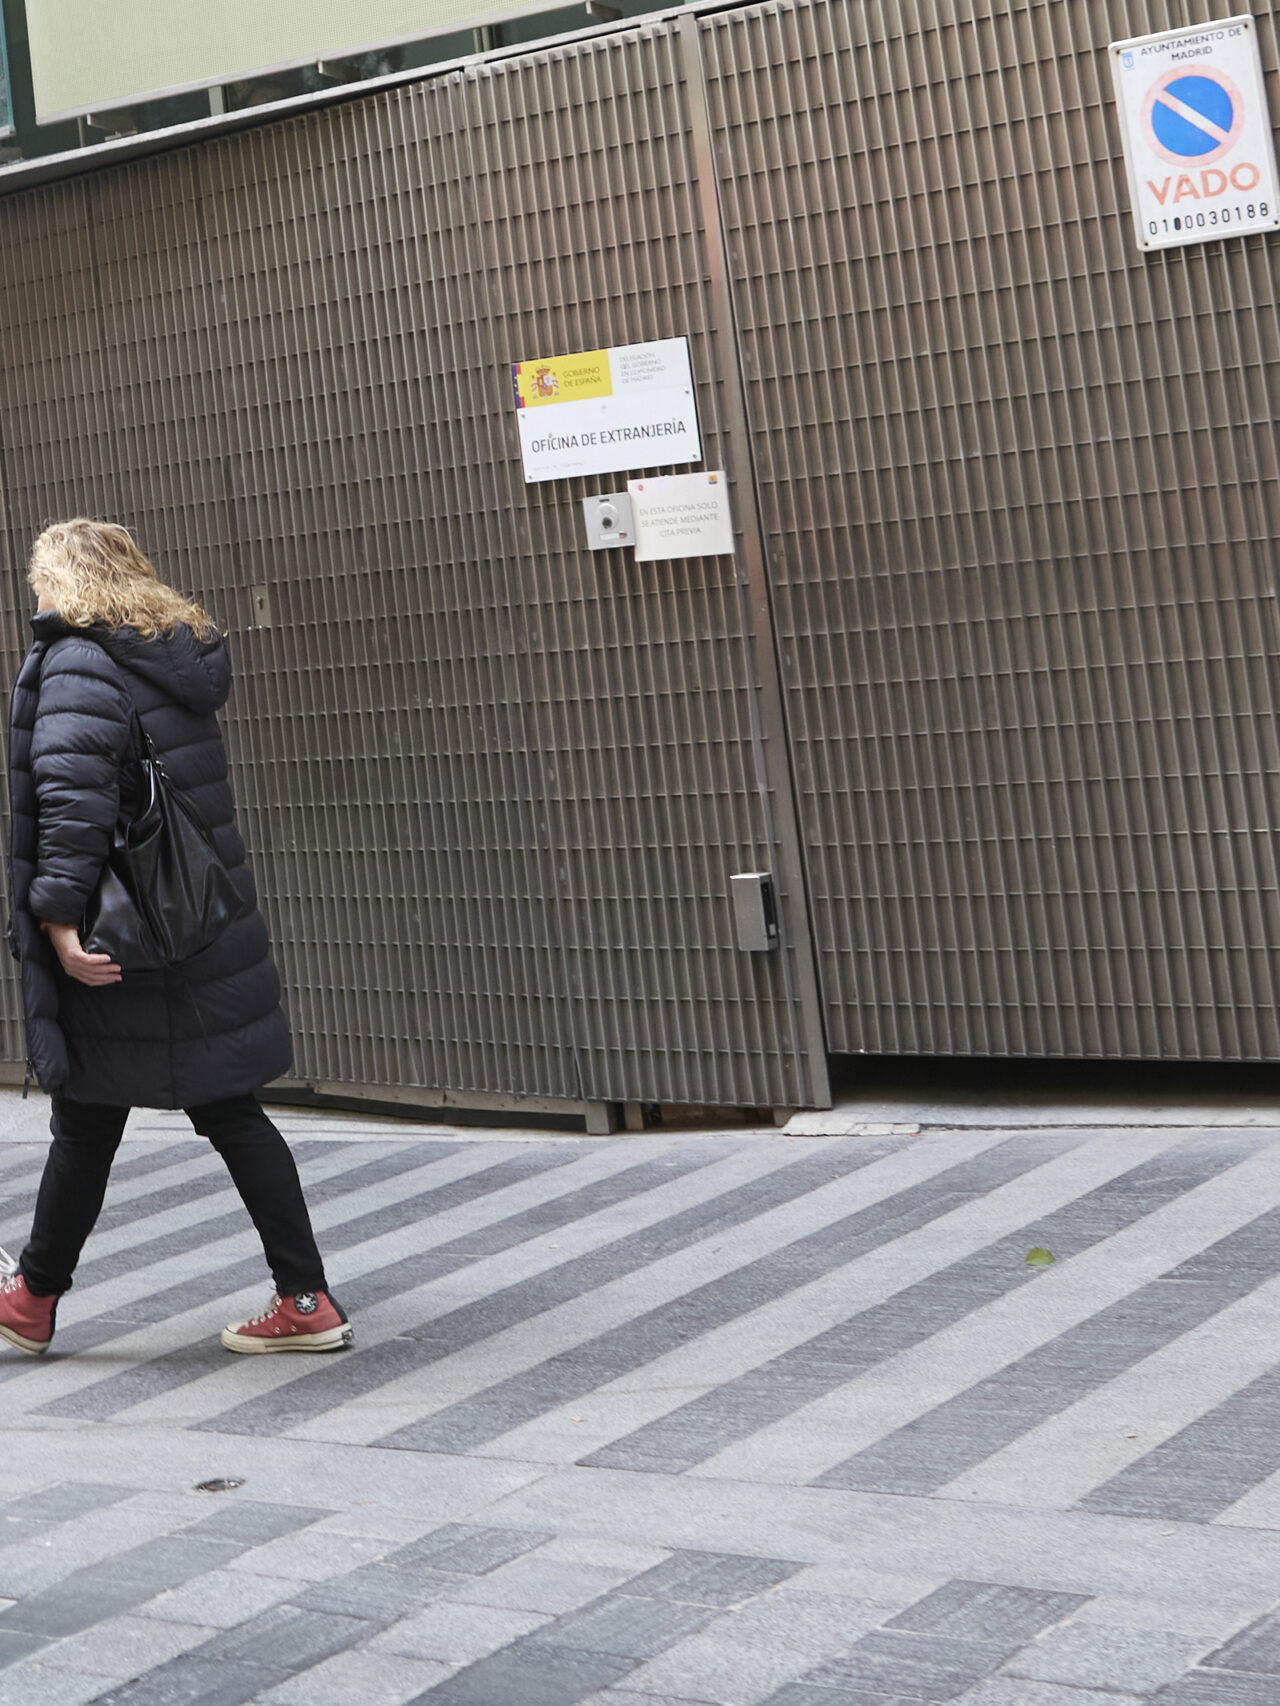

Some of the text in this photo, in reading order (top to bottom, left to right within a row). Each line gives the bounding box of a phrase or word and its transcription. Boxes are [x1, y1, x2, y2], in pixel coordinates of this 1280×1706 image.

[1140, 27, 1242, 56] AYUNTAMIENTO DE
[1171, 46, 1213, 61] MADRID
[1146, 162, 1260, 206] VADO
[562, 366, 600, 378] GOBIERNO
[563, 380, 573, 388] DE
[531, 419, 686, 453] OFICINA DE EXTRANJERÍA
